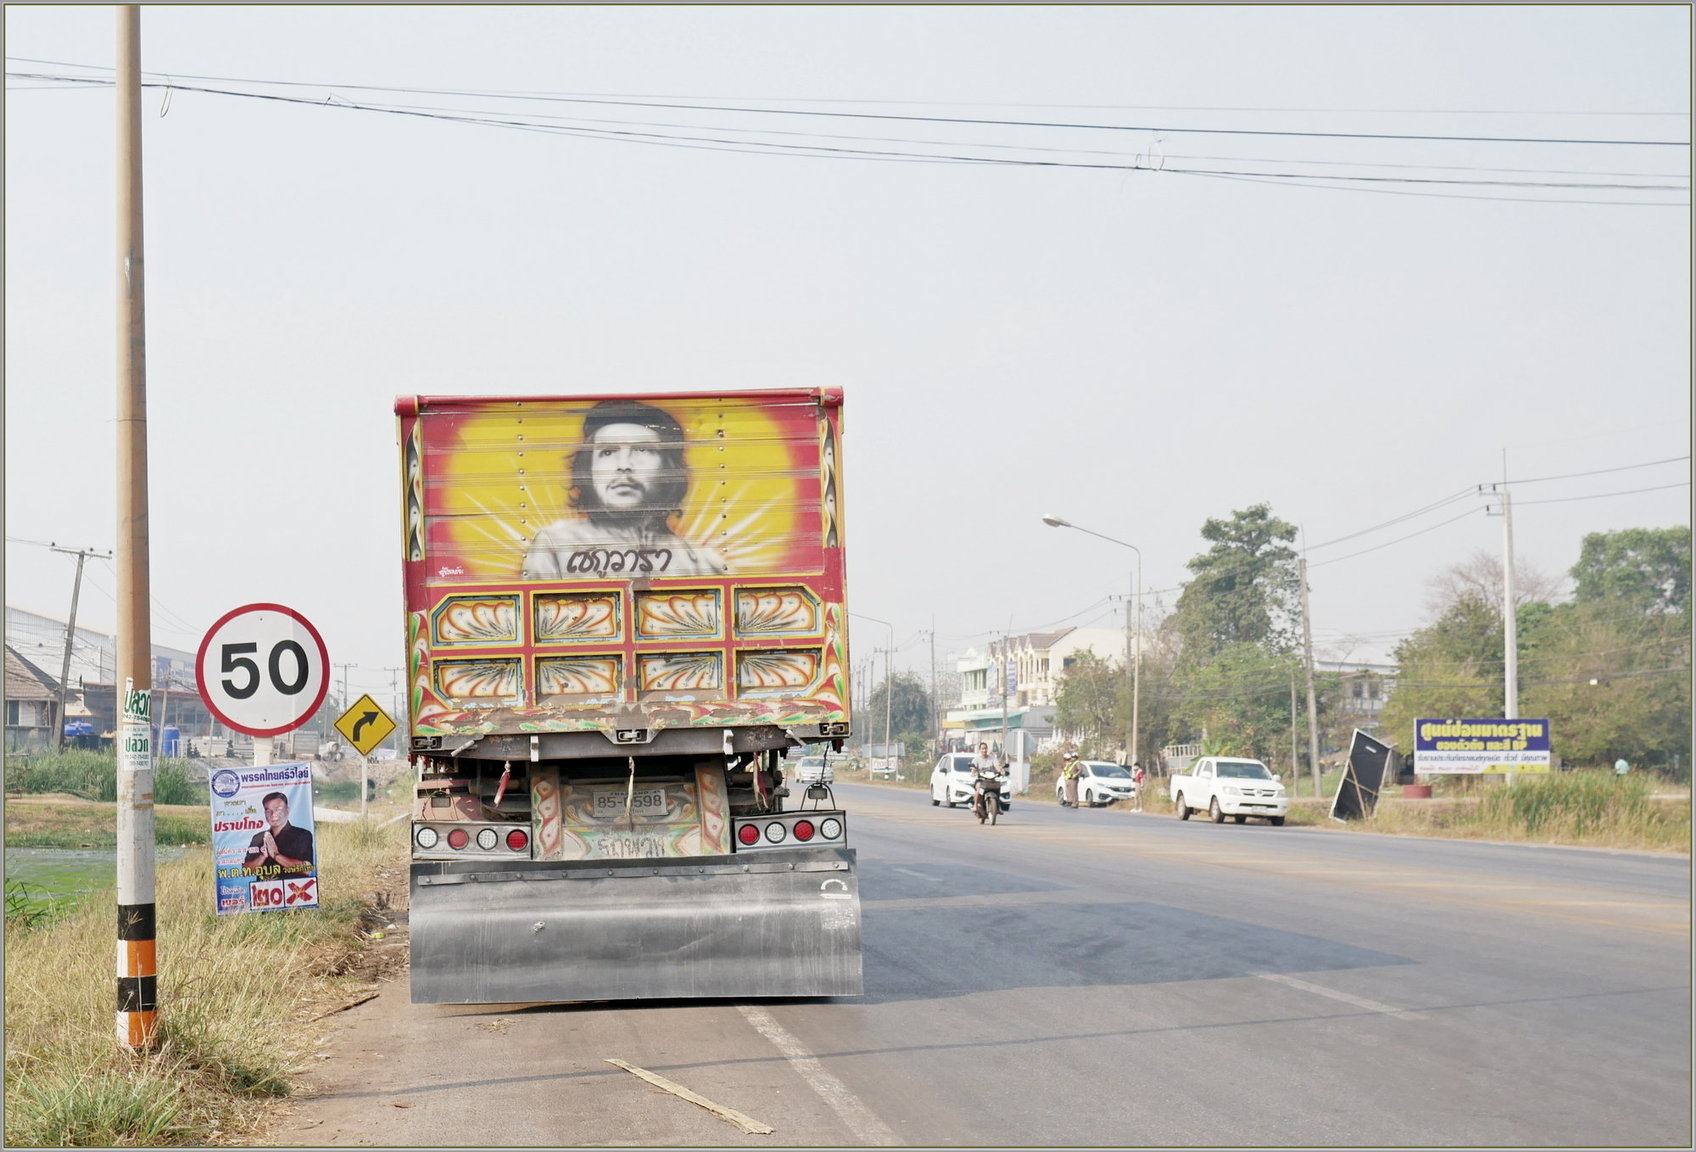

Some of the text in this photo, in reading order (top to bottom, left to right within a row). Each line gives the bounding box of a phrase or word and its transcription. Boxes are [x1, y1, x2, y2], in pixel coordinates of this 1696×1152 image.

[221, 639, 309, 700] 50
[125, 737, 148, 752] ปลวก
[214, 816, 264, 832] ปราบโกง
[218, 865, 281, 880] พ.ต.ท.อุบล
